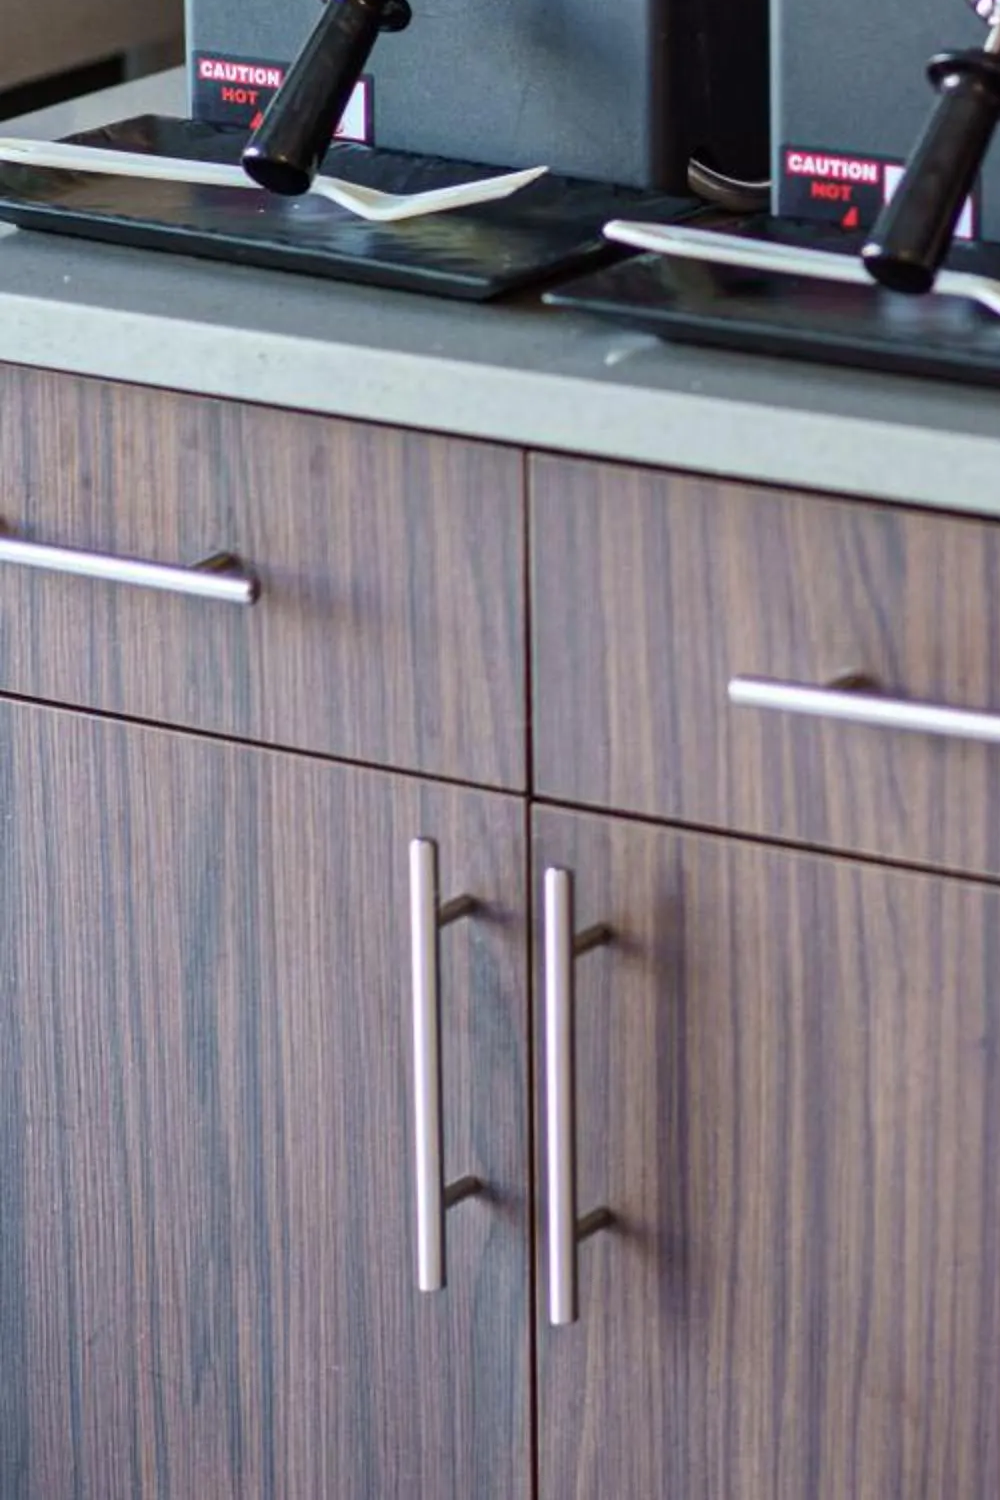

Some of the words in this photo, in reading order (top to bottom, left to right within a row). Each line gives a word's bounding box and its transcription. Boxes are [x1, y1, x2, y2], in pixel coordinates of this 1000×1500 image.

[199, 61, 281, 86] CAUTION
[221, 87, 259, 105] HOT
[787, 154, 878, 181] CAUTION
[811, 181, 853, 201] HOT
